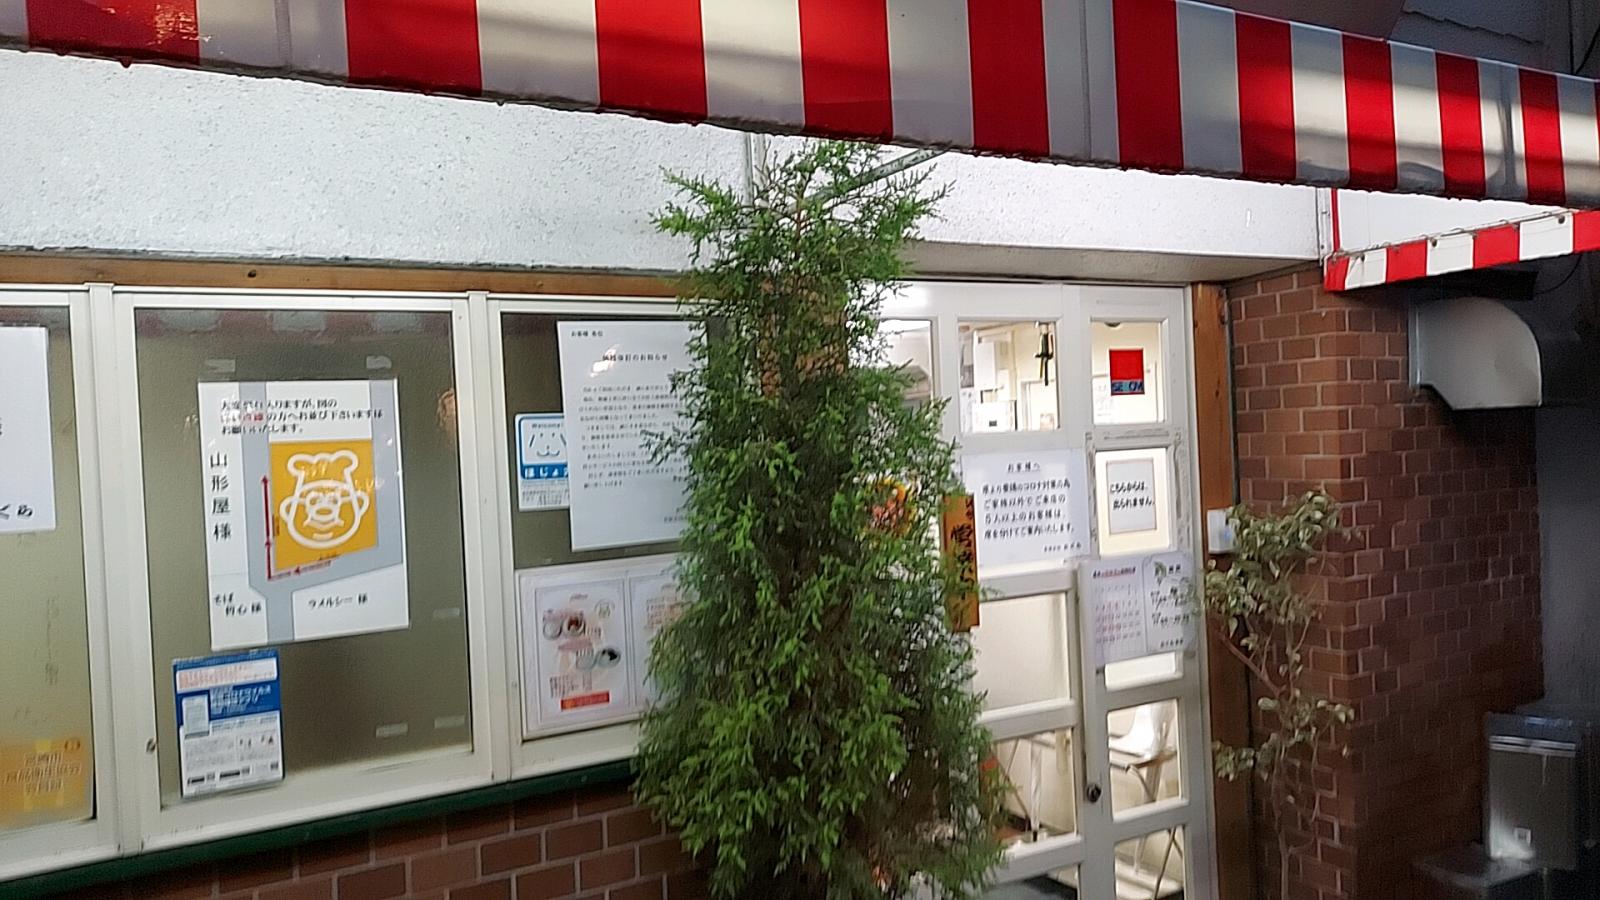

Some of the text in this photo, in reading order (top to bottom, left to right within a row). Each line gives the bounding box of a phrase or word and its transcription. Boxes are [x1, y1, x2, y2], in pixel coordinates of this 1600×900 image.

[1111, 381, 1143, 391] SEOM
[210, 452, 231, 540] 山形屋様
